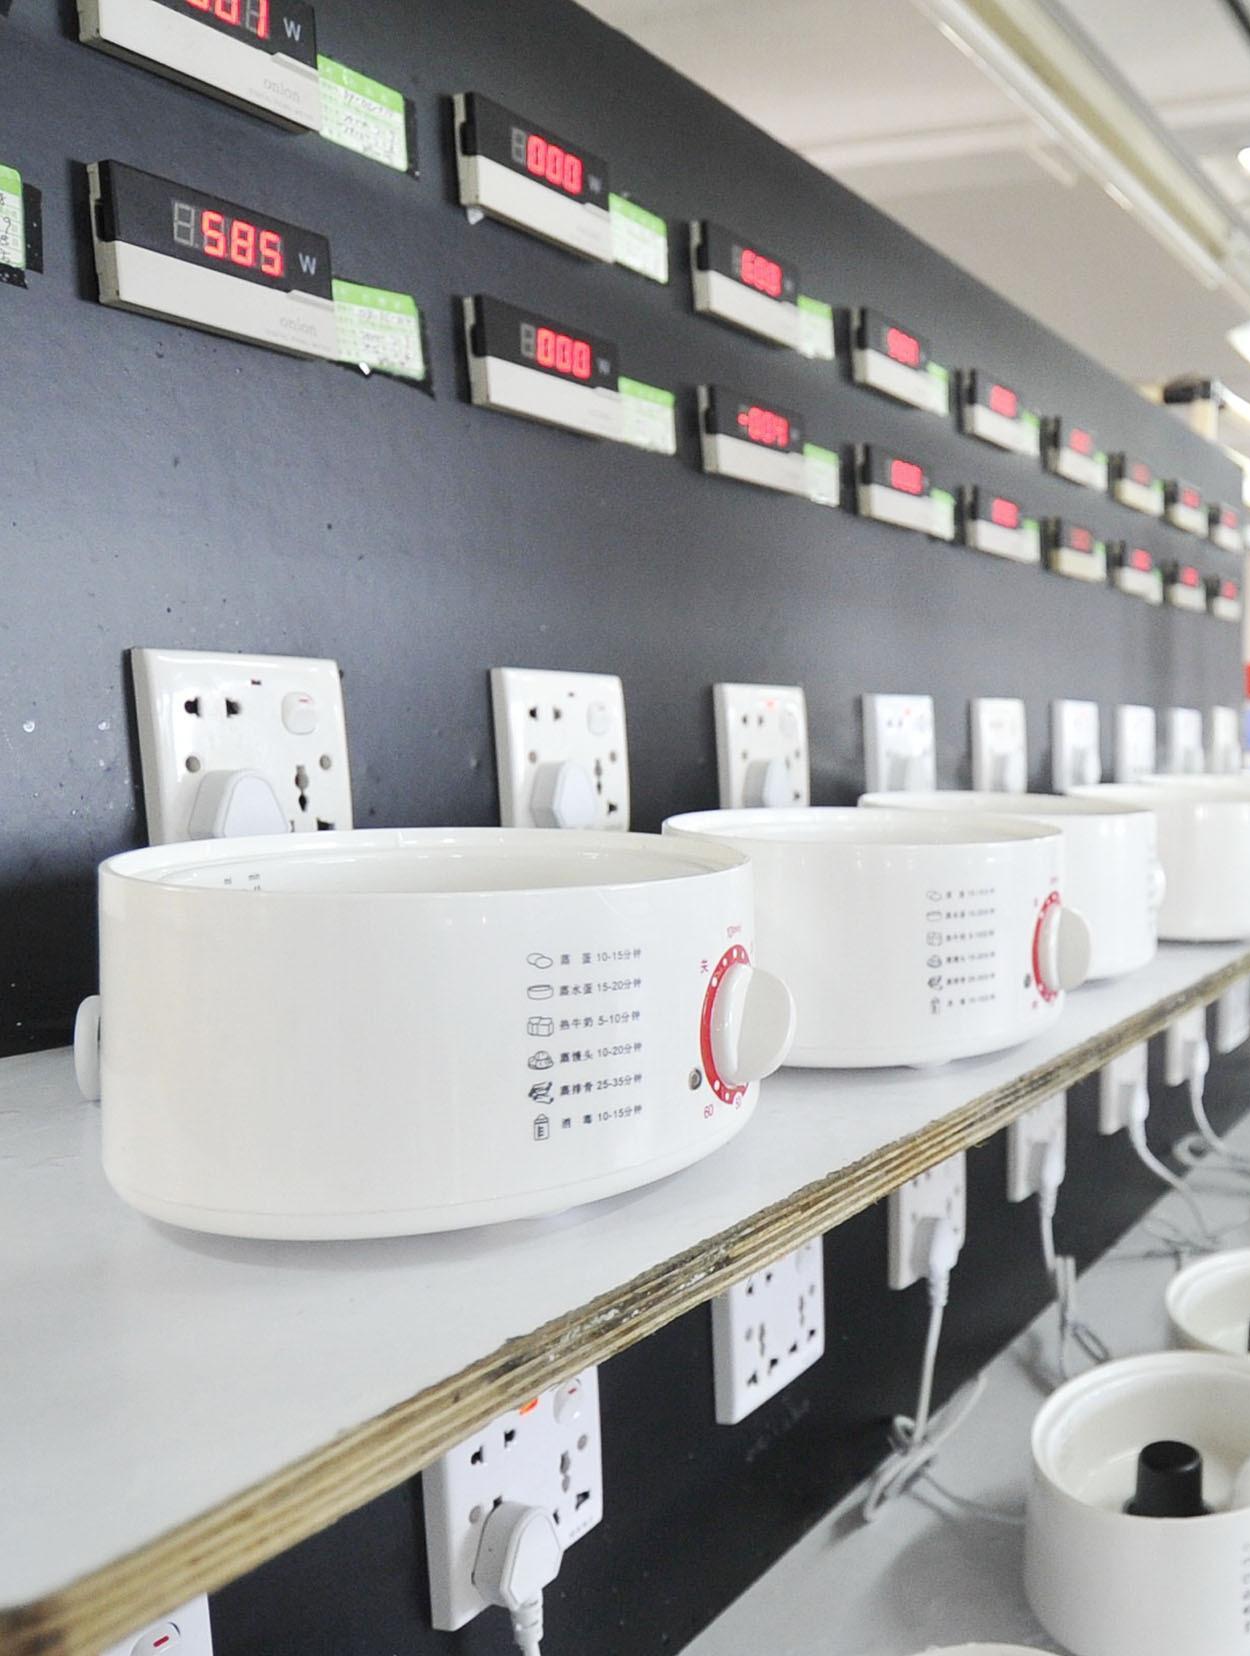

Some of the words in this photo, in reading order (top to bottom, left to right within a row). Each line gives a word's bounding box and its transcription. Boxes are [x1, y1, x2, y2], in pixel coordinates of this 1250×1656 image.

[283, 17, 301, 41] W
[201, 211, 283, 277] 585
[299, 253, 316, 276] W
